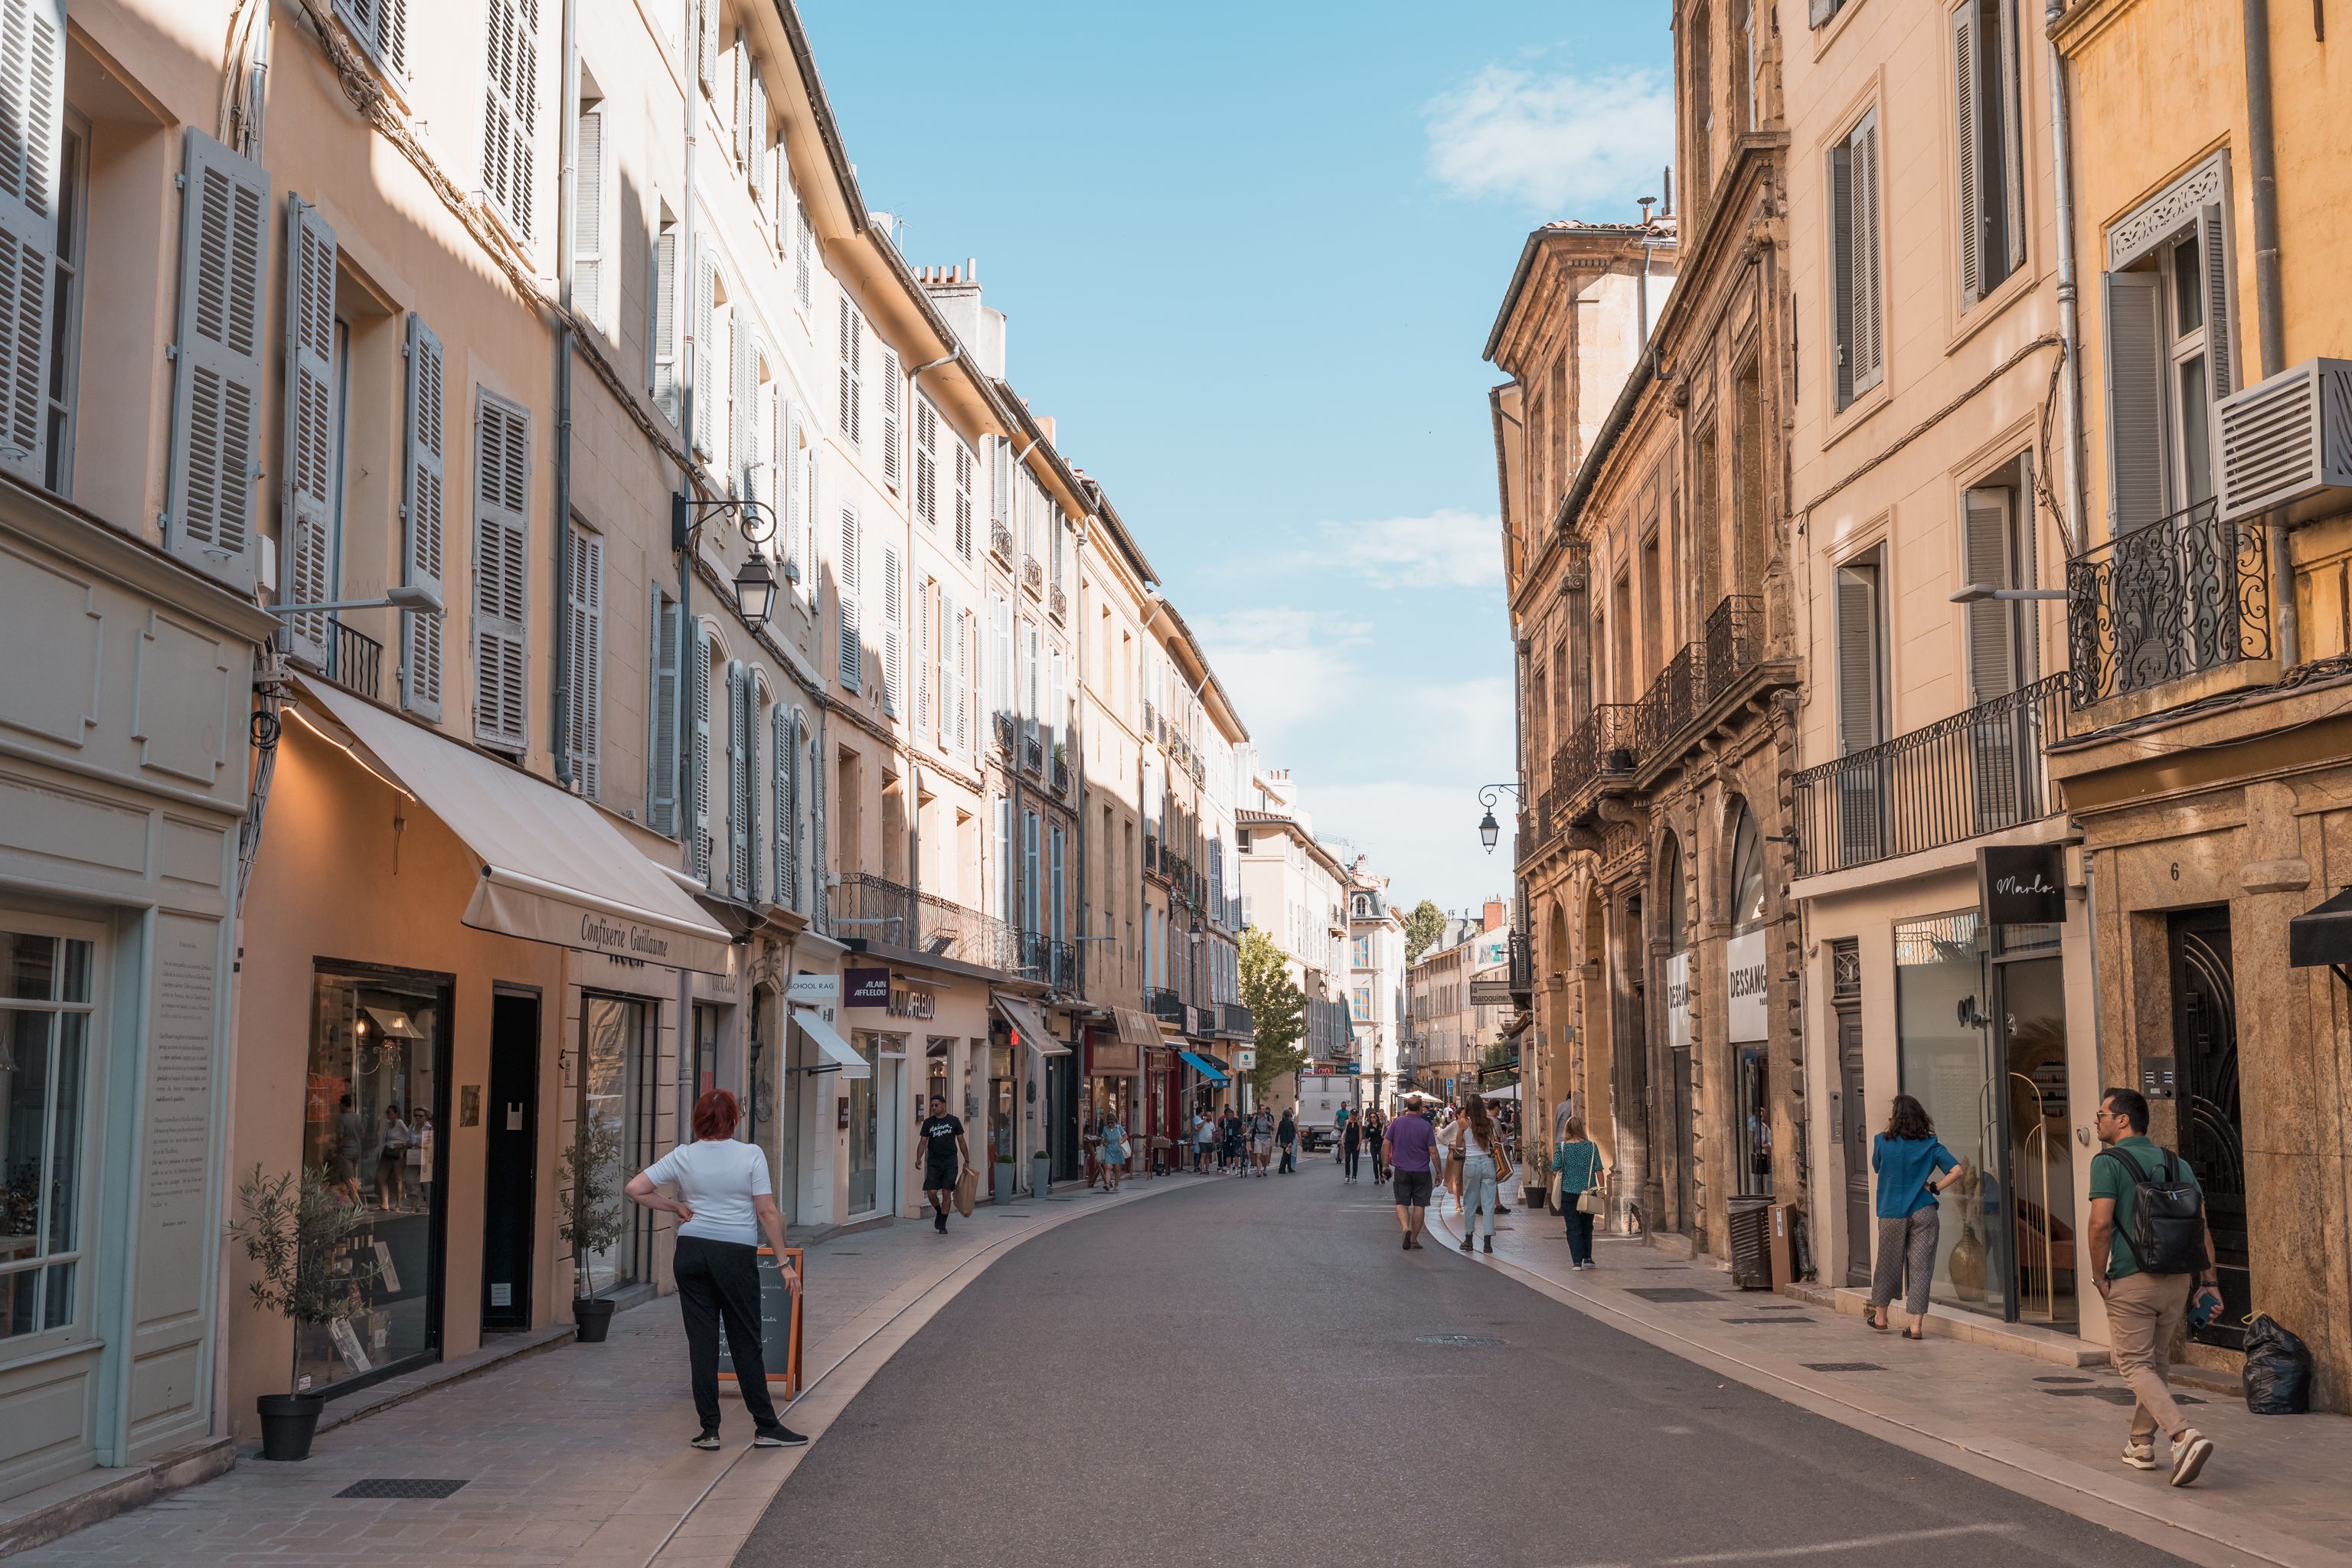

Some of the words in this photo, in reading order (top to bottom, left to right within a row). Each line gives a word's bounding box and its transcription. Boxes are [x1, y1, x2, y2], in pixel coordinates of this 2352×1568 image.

[1997, 874, 2055, 894] Marlo.
[2171, 862, 2179, 880] 6
[581, 913, 626, 950] Confiserie
[630, 926, 668, 958] Guillaume
[906, 991, 936, 1019] AFFLELOU
[1669, 981, 1691, 1009] DESSAN
